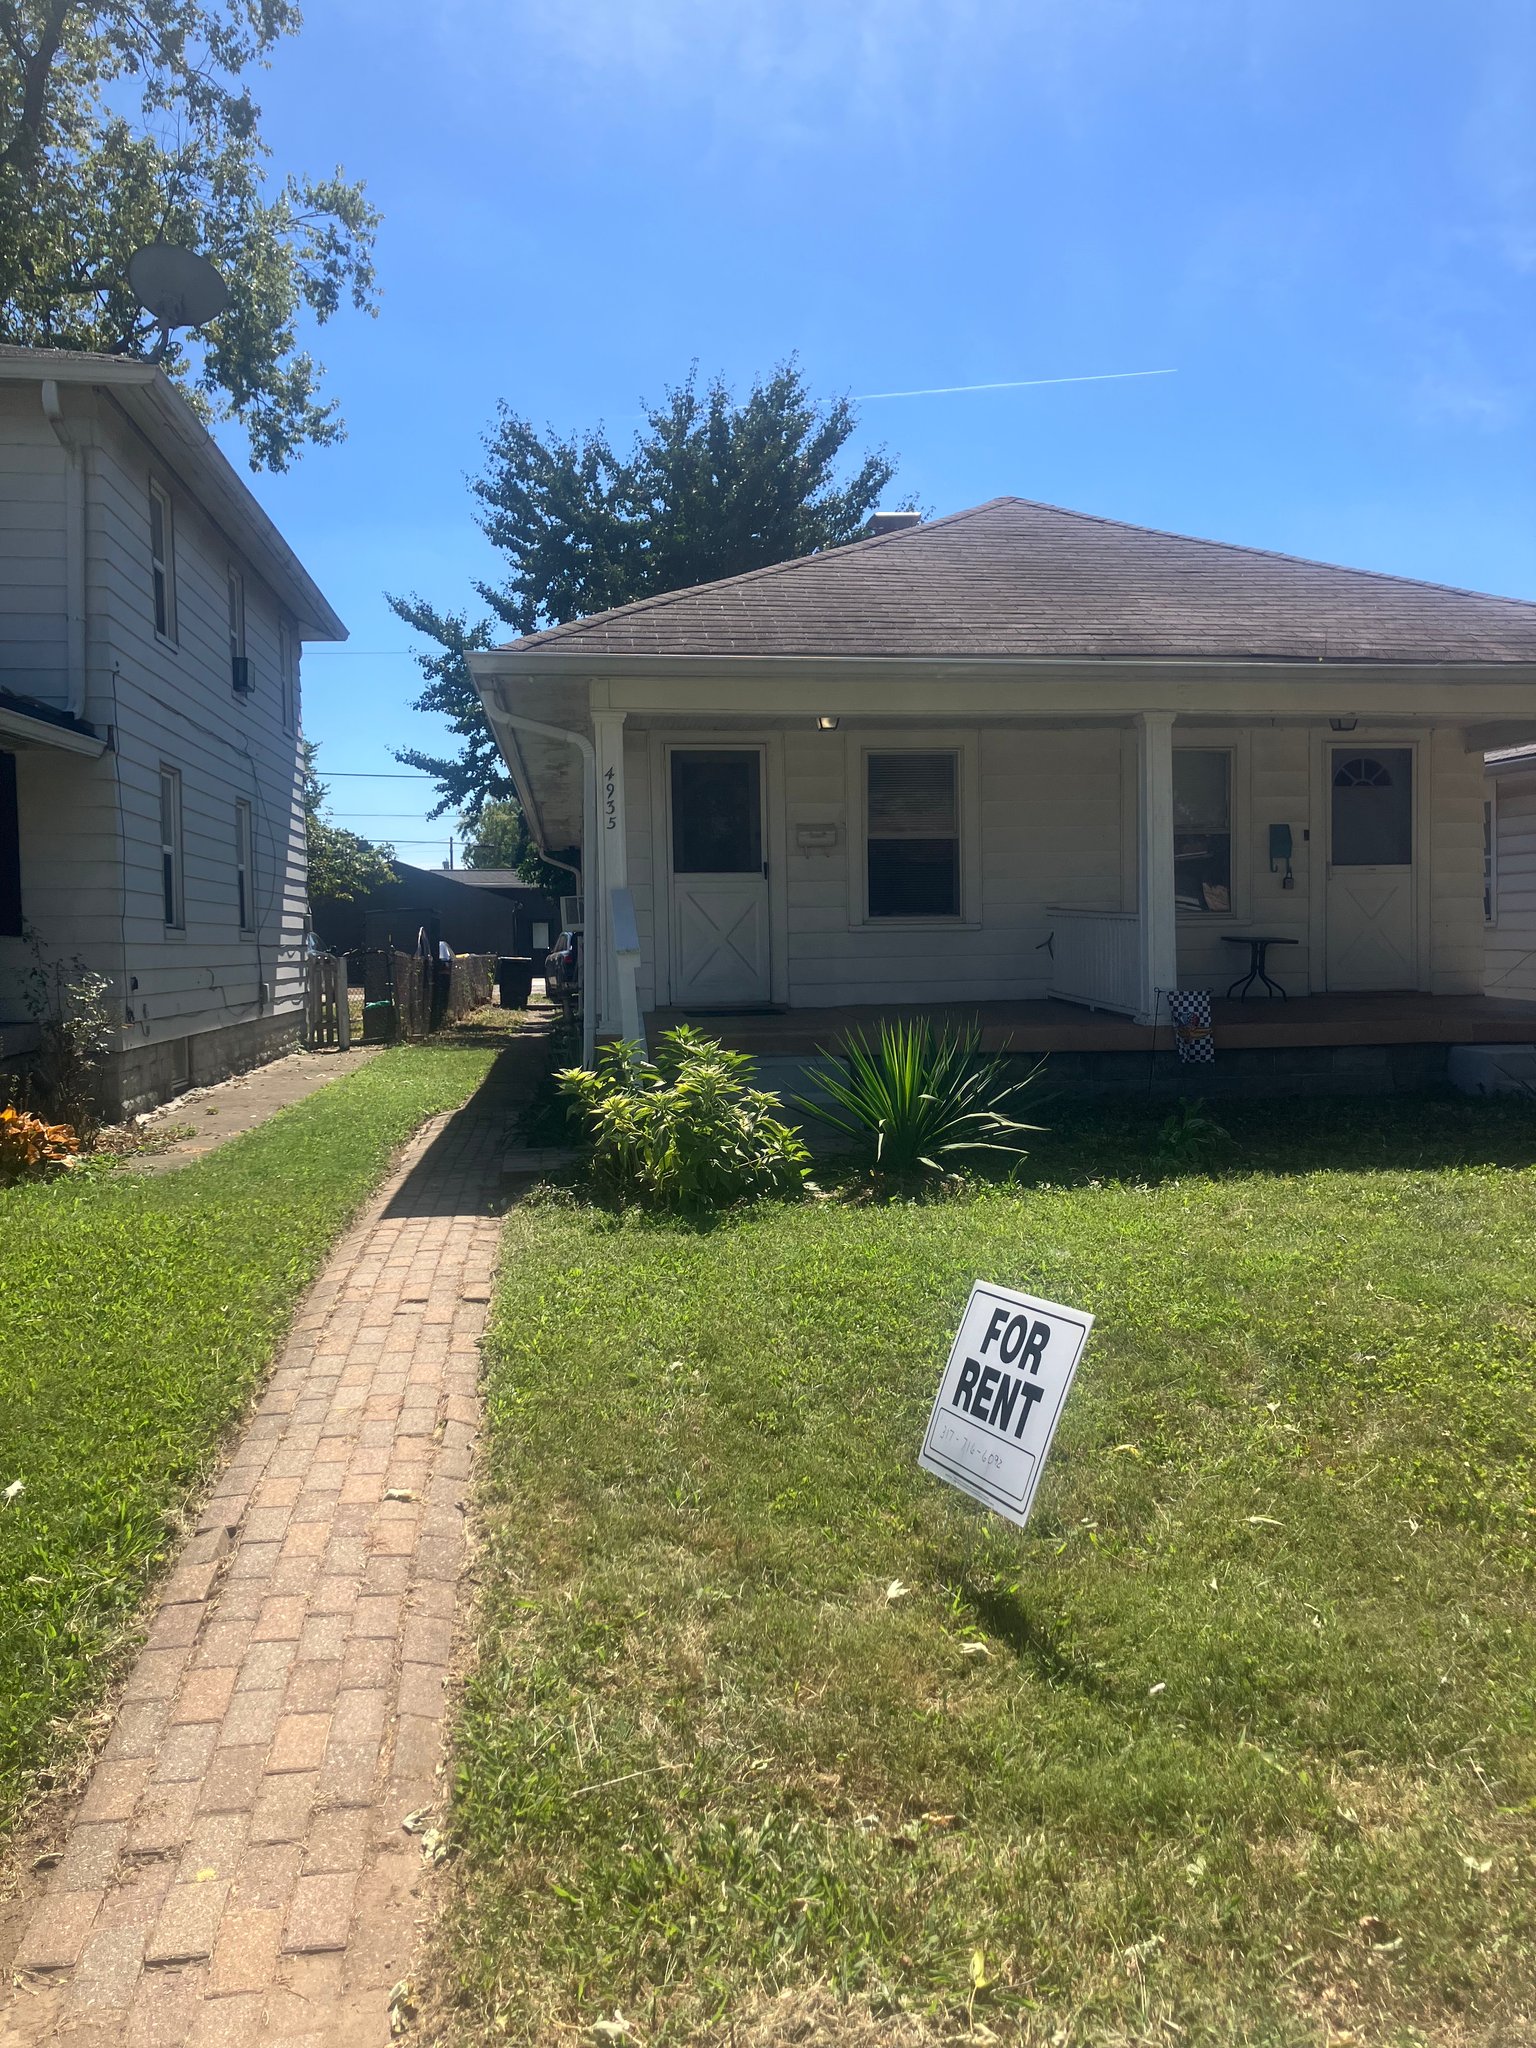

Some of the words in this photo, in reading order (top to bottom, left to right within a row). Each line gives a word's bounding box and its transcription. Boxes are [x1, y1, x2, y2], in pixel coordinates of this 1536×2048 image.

[604, 766, 616, 830] 4935
[979, 1307, 1051, 1376] FOR
[952, 1356, 1045, 1440] RENT
